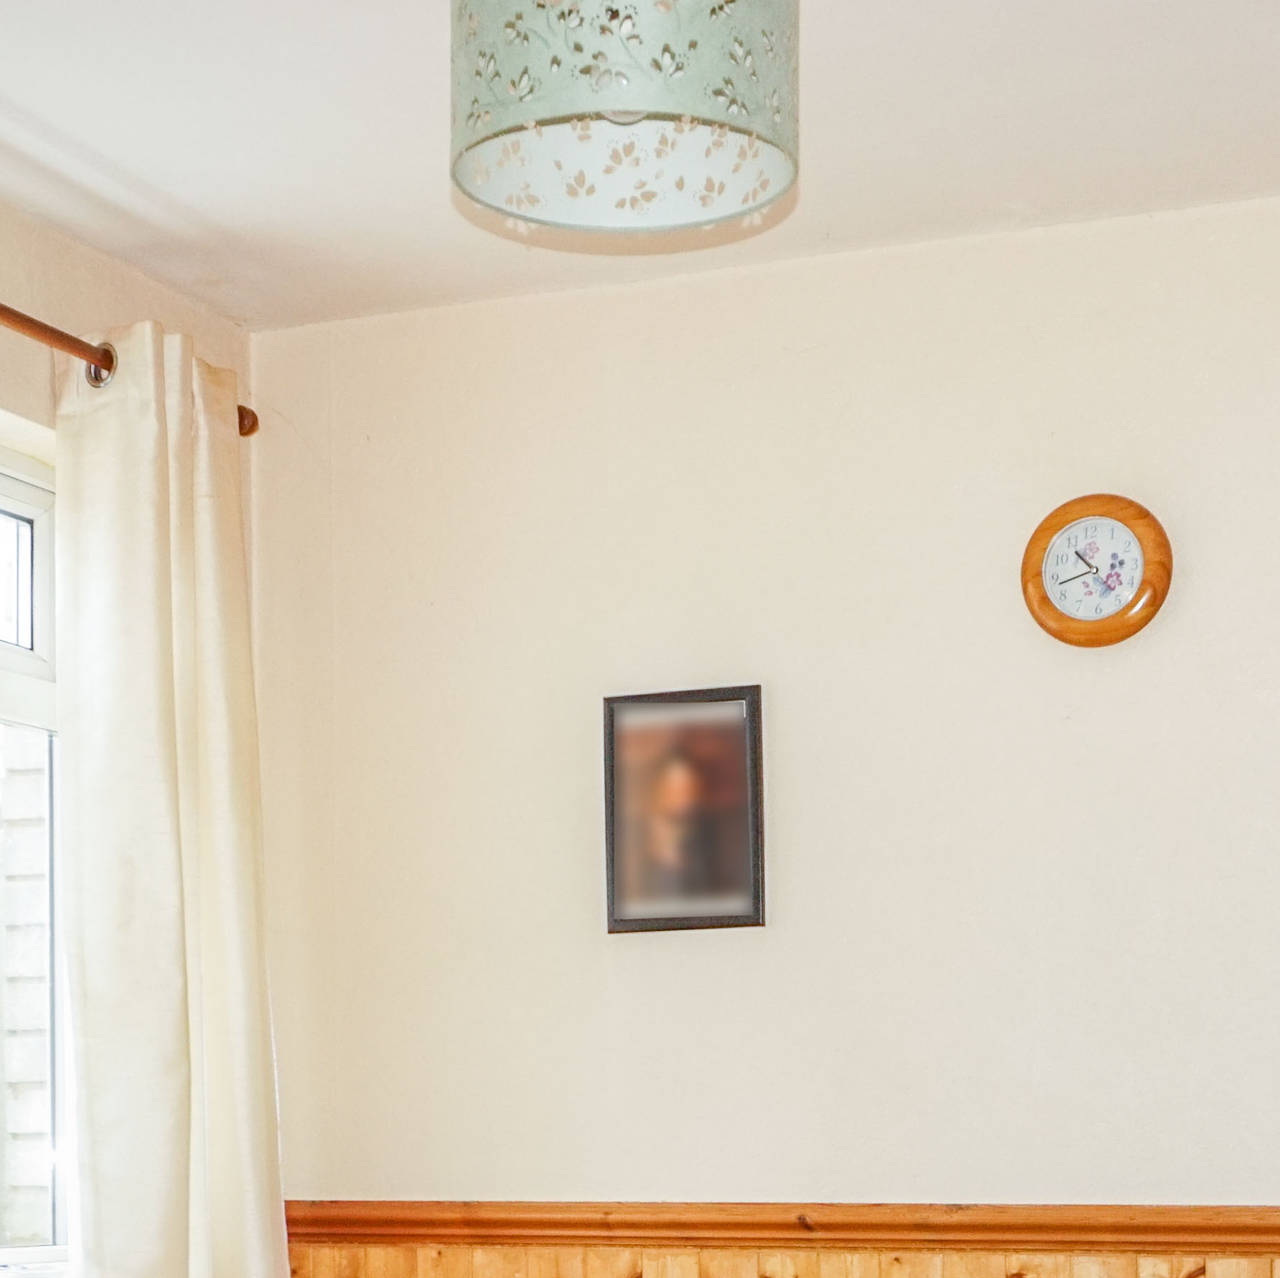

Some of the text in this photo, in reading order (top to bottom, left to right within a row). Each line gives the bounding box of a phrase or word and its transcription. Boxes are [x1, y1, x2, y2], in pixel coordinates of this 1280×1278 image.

[1084, 526, 1097, 538] 12
[1109, 528, 1115, 539] 1
[1067, 535, 1078, 548] 11
[1124, 540, 1131, 552] 2
[1055, 552, 1068, 566] 10
[1131, 559, 1138, 571] 3
[1051, 574, 1058, 585] 9
[1127, 576, 1134, 588] 4
[1060, 590, 1067, 601] 8
[1115, 595, 1122, 605] 5
[1075, 600, 1082, 612] 7
[1095, 603, 1102, 615] 6
